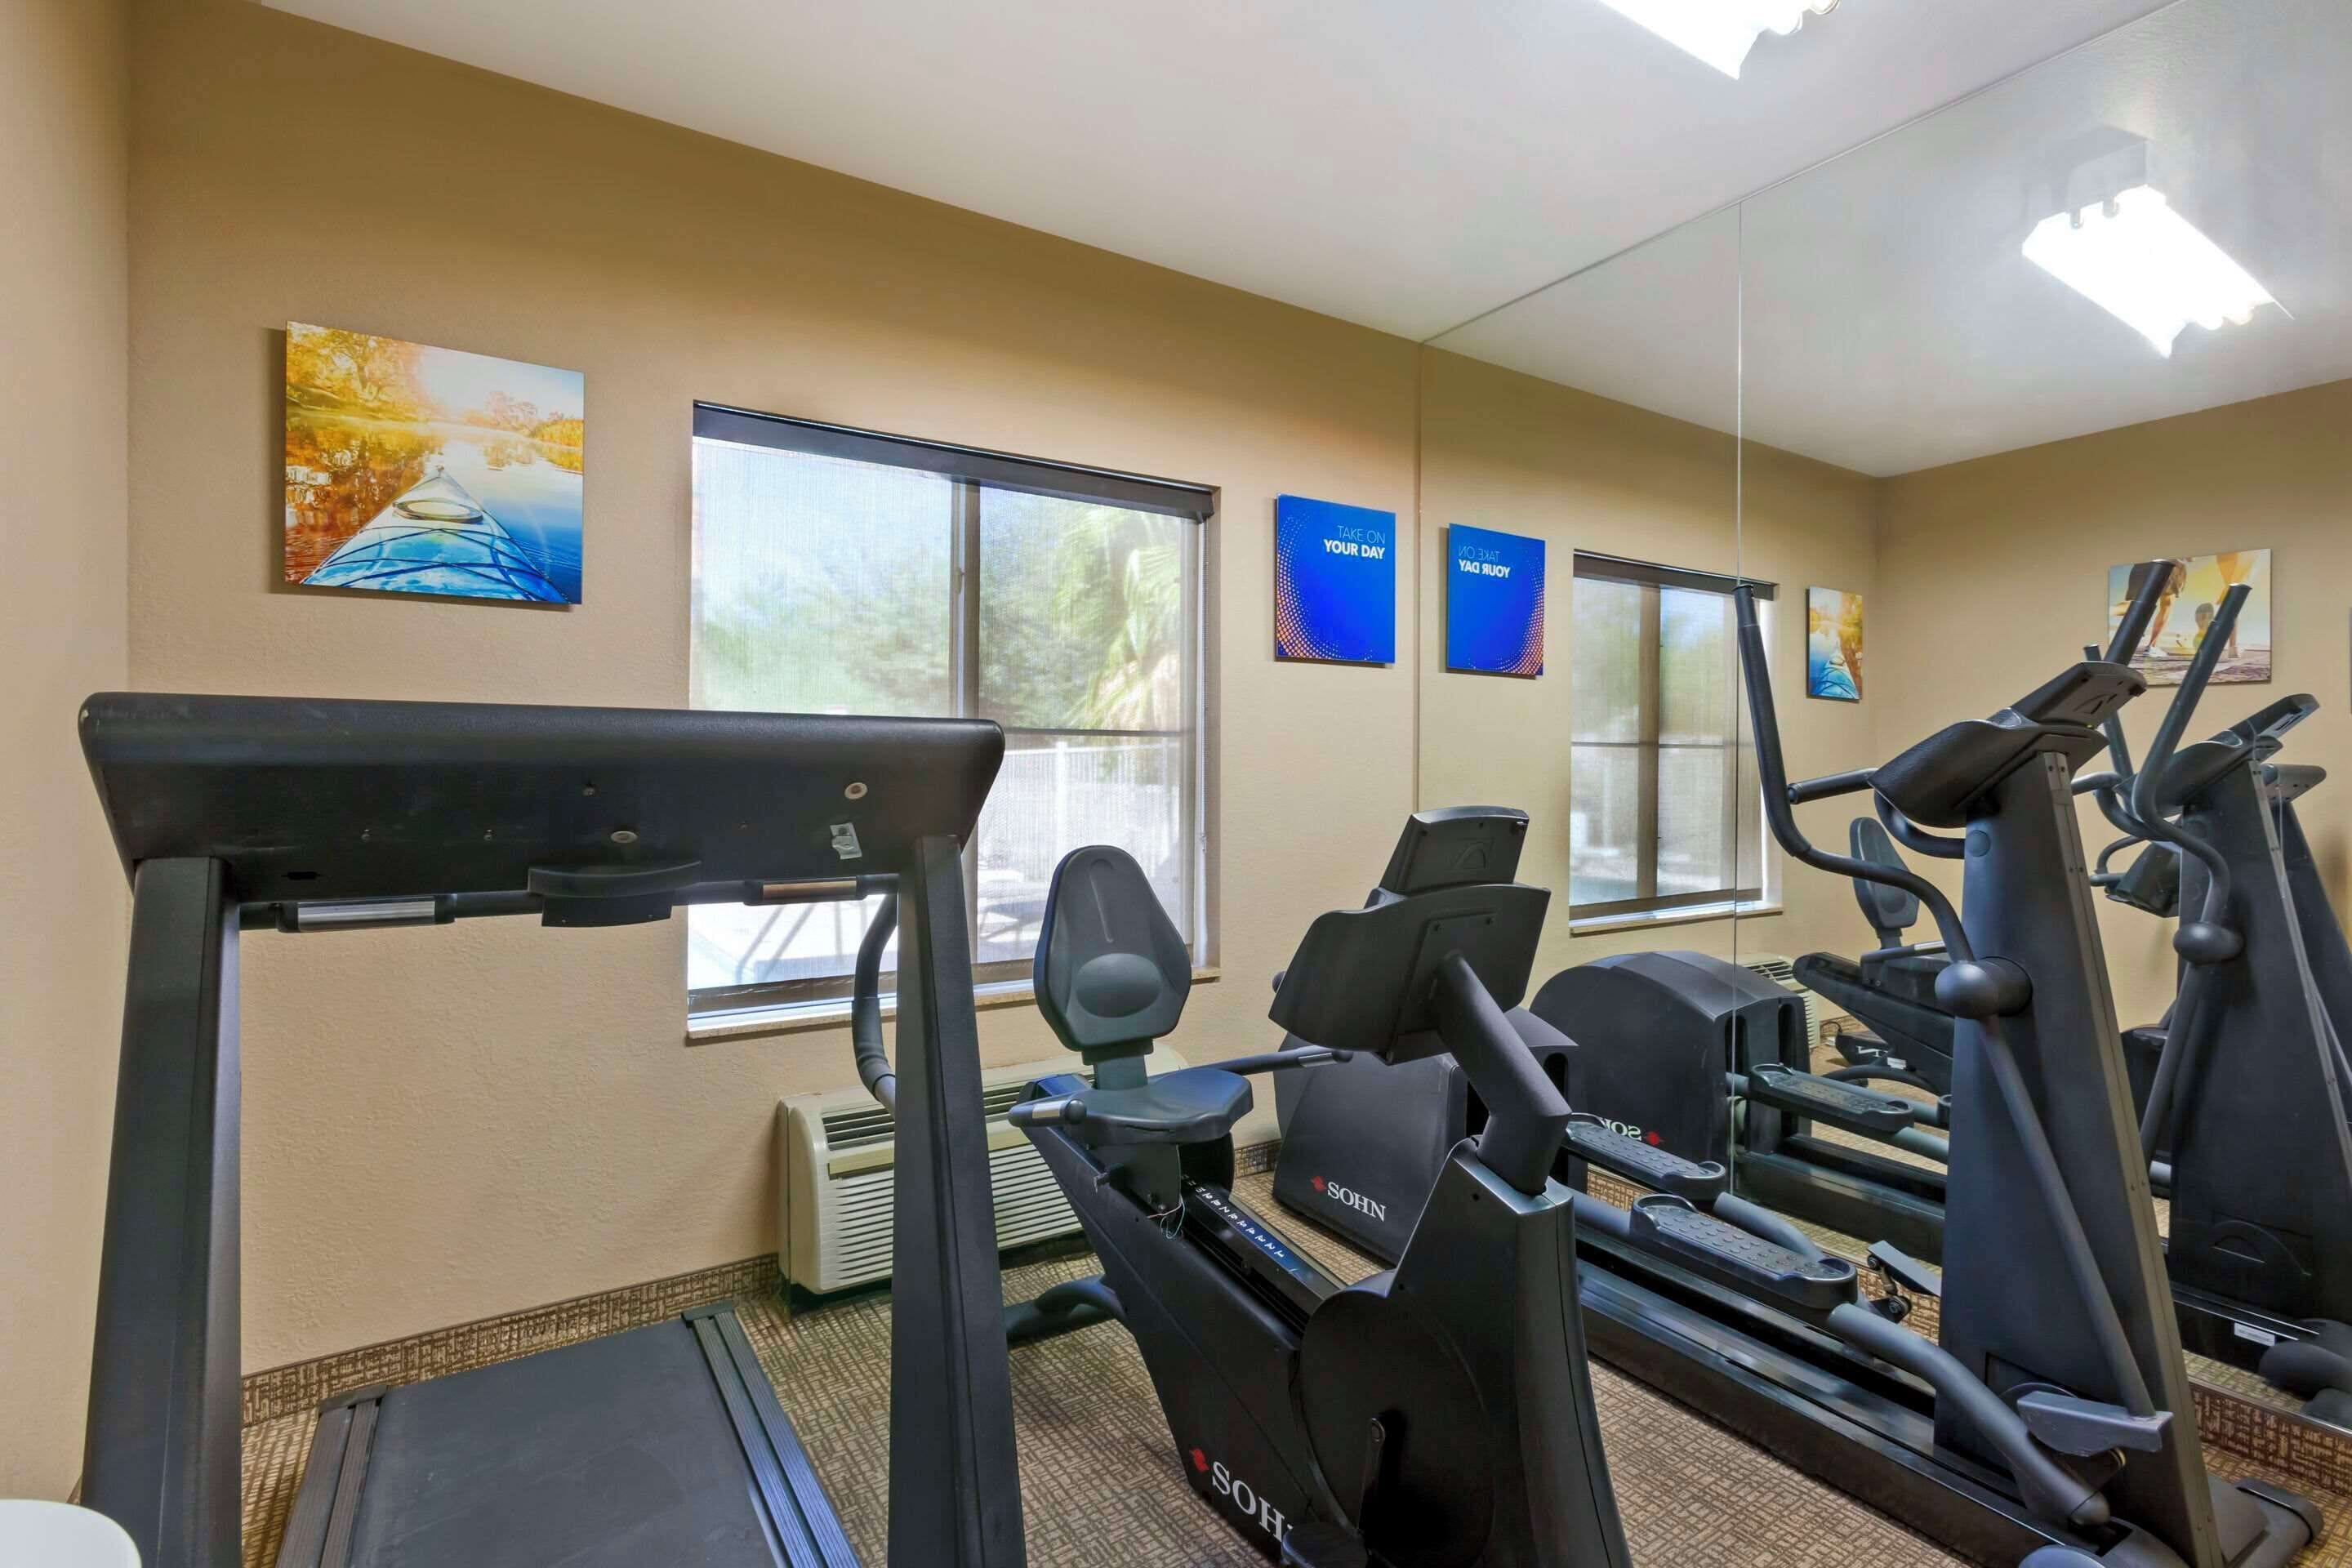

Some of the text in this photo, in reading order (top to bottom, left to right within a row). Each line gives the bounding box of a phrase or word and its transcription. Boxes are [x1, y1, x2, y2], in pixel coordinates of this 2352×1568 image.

[1323, 538, 1386, 559] YOUR DAY
[1337, 525, 1385, 545] TAKE ON
[1327, 1182, 1387, 1222] SOHN
[1212, 1461, 1294, 1542] SOH
